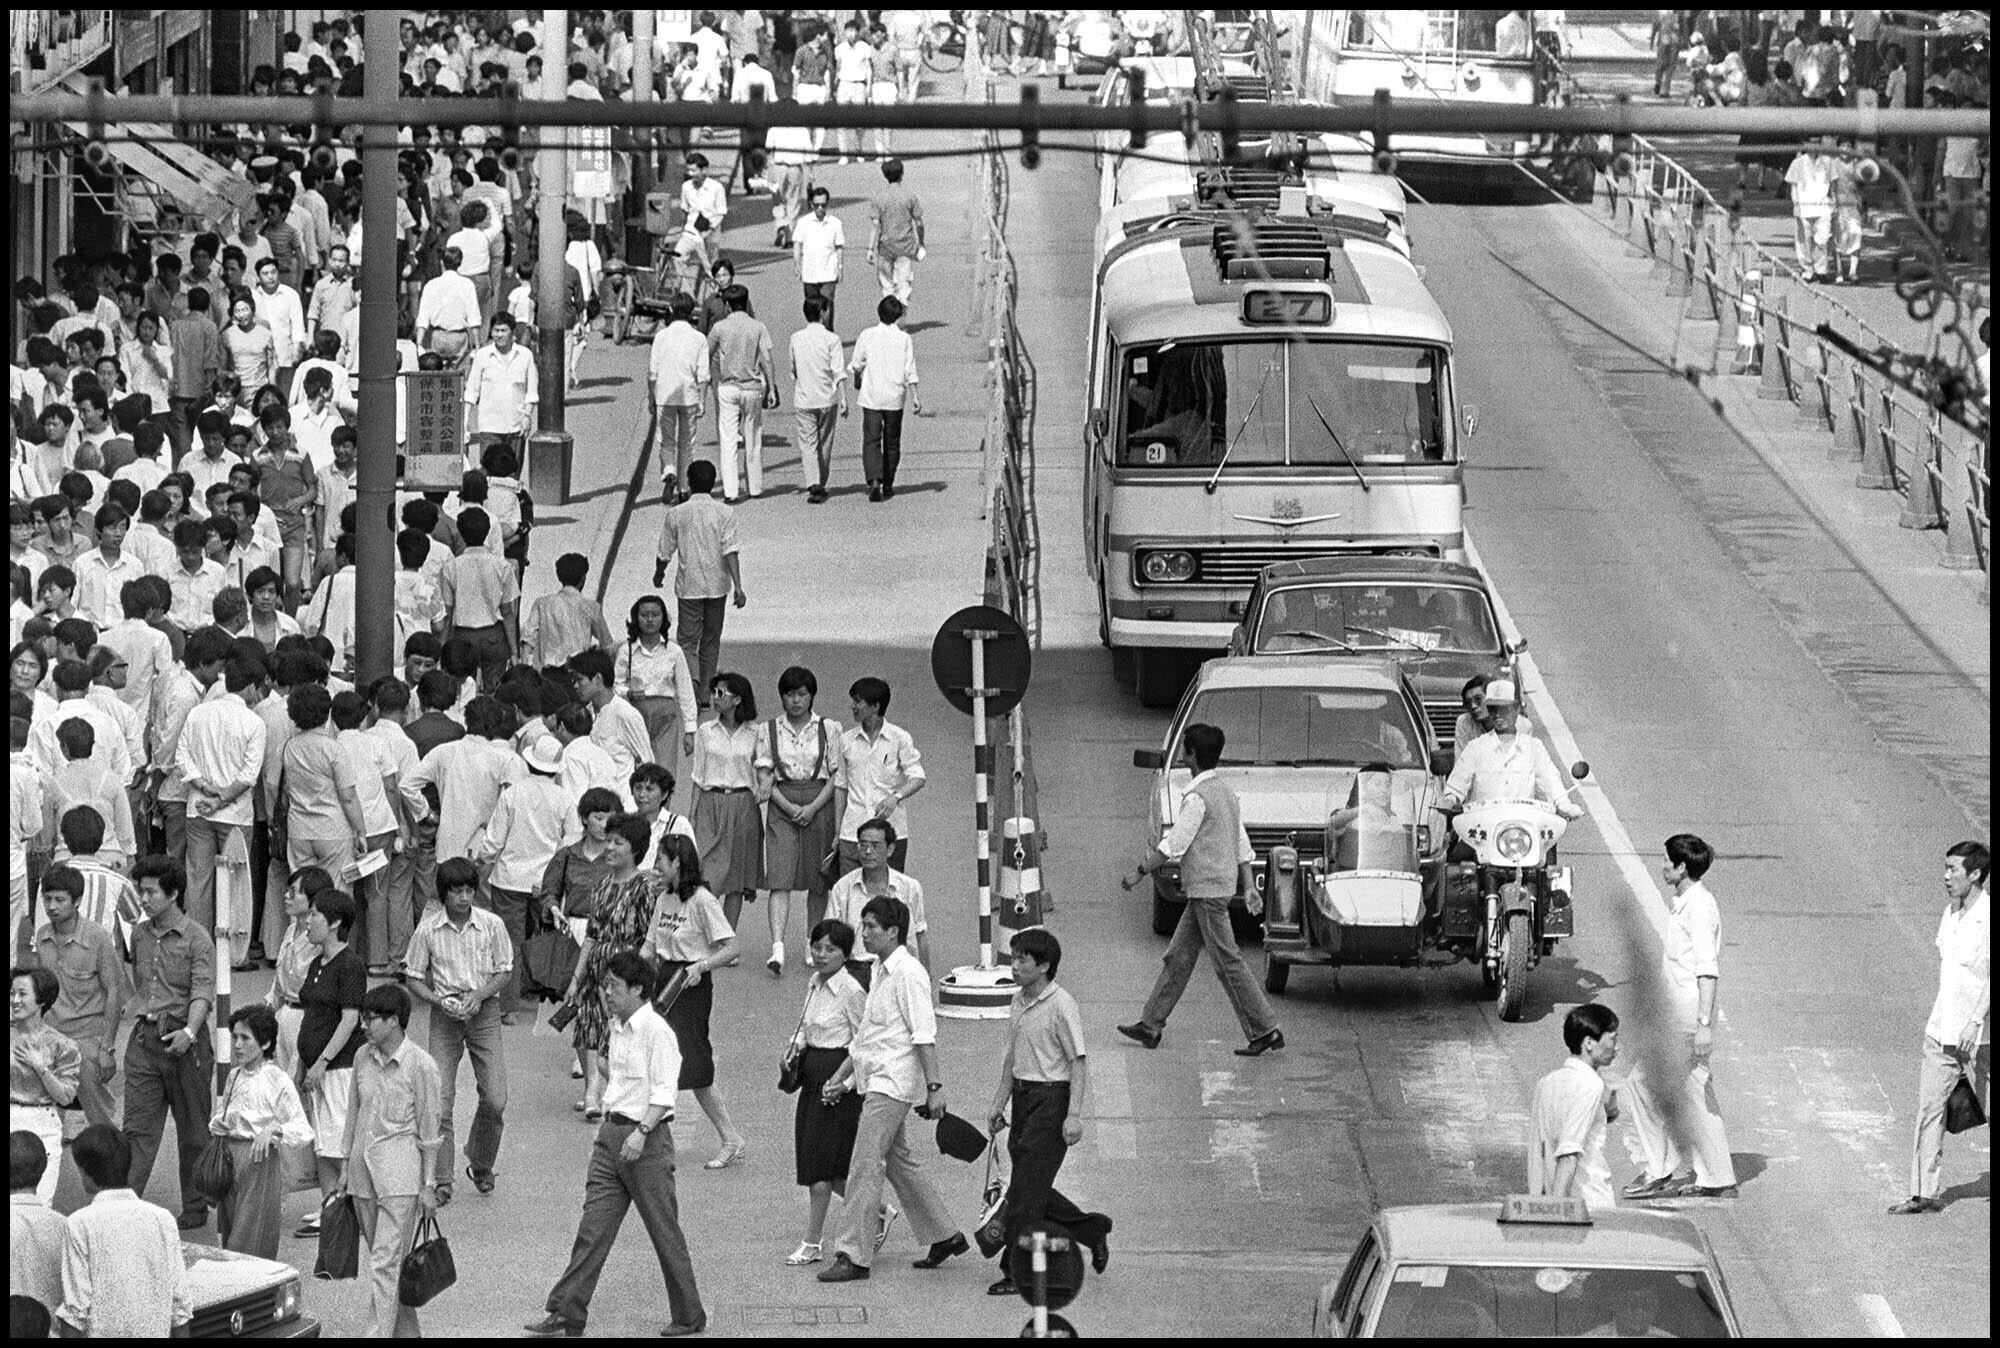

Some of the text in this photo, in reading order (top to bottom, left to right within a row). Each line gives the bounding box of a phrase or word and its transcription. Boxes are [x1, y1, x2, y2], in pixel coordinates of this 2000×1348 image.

[1263, 299, 1314, 316] 27
[420, 377, 434, 453] 保持市容整洁
[440, 377, 455, 453] 维护社会公德
[1149, 447, 1160, 460] 21
